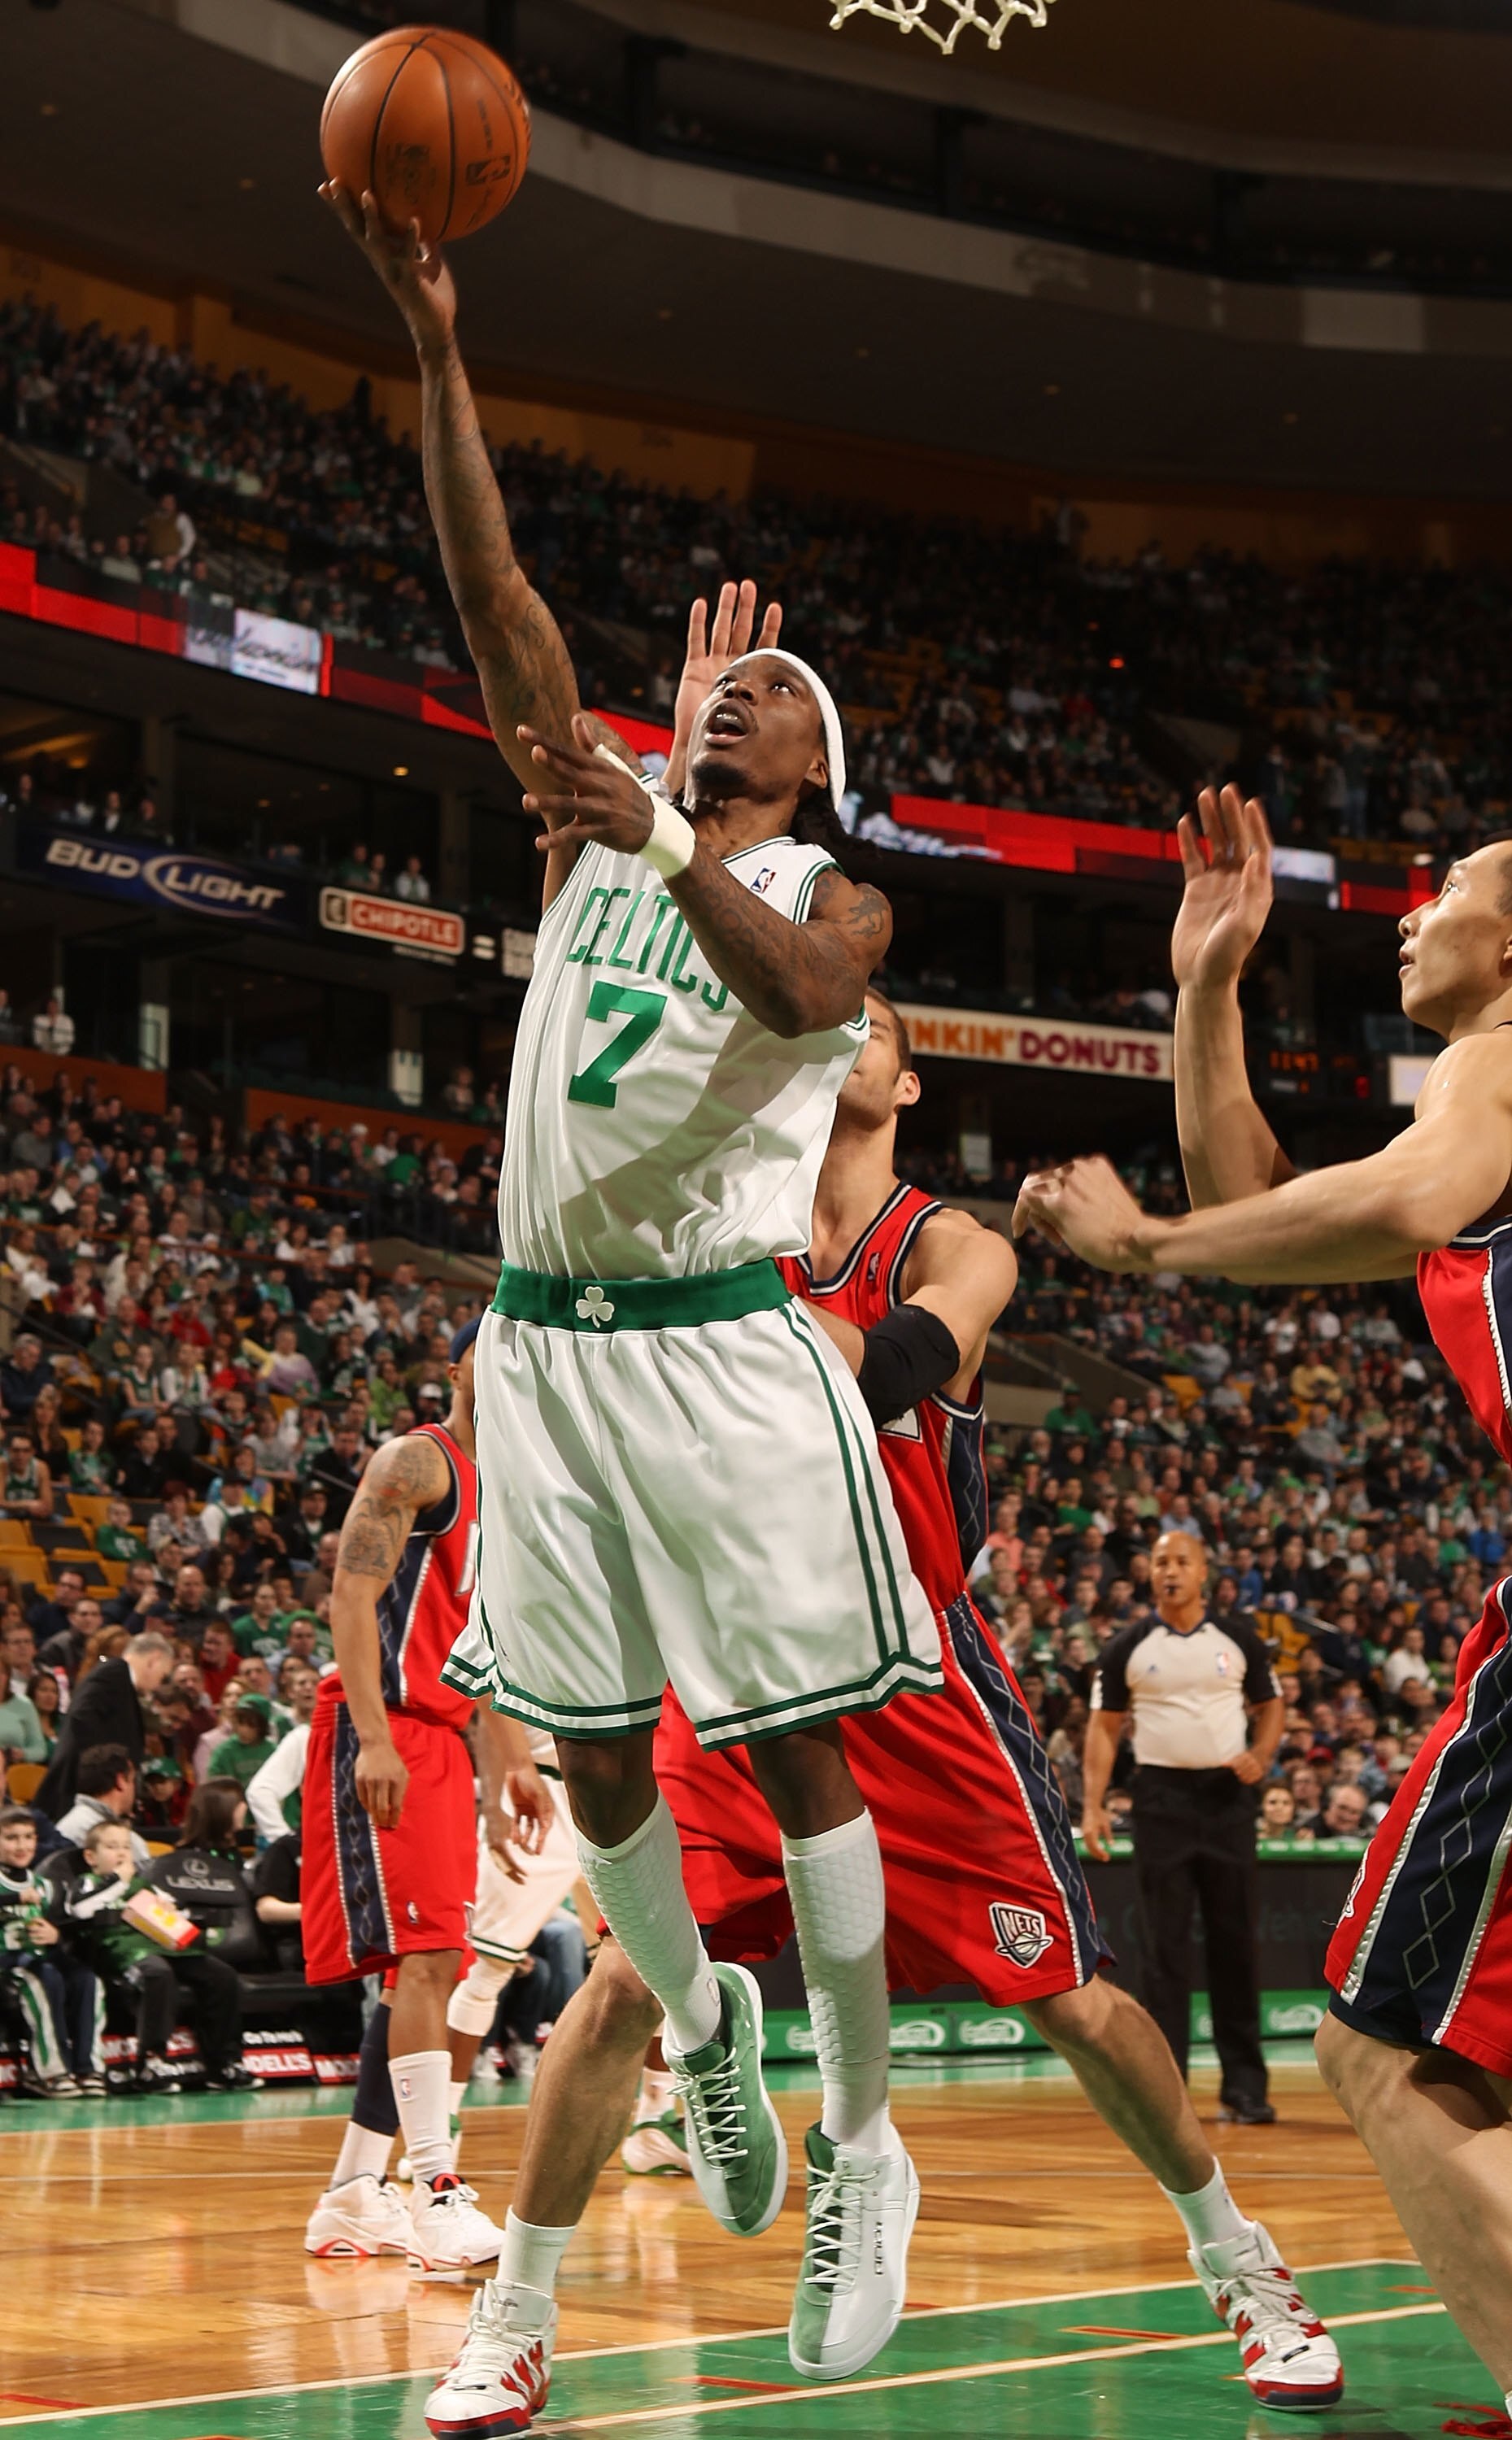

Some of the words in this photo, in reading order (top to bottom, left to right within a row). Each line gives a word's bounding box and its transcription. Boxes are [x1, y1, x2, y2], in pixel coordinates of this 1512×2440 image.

[46, 839, 141, 879] BUD
[164, 865, 285, 909] LIGHT
[353, 904, 456, 942] CHIPOTLE
[568, 980, 668, 1109] 7
[904, 1018, 1013, 1058] NKIN'
[1020, 1028, 1161, 1075] DONUTS
[165, 1874, 237, 1893] LEXUS
[1000, 1909, 1042, 1943] NETS
[242, 2052, 313, 2073] DELL'S
